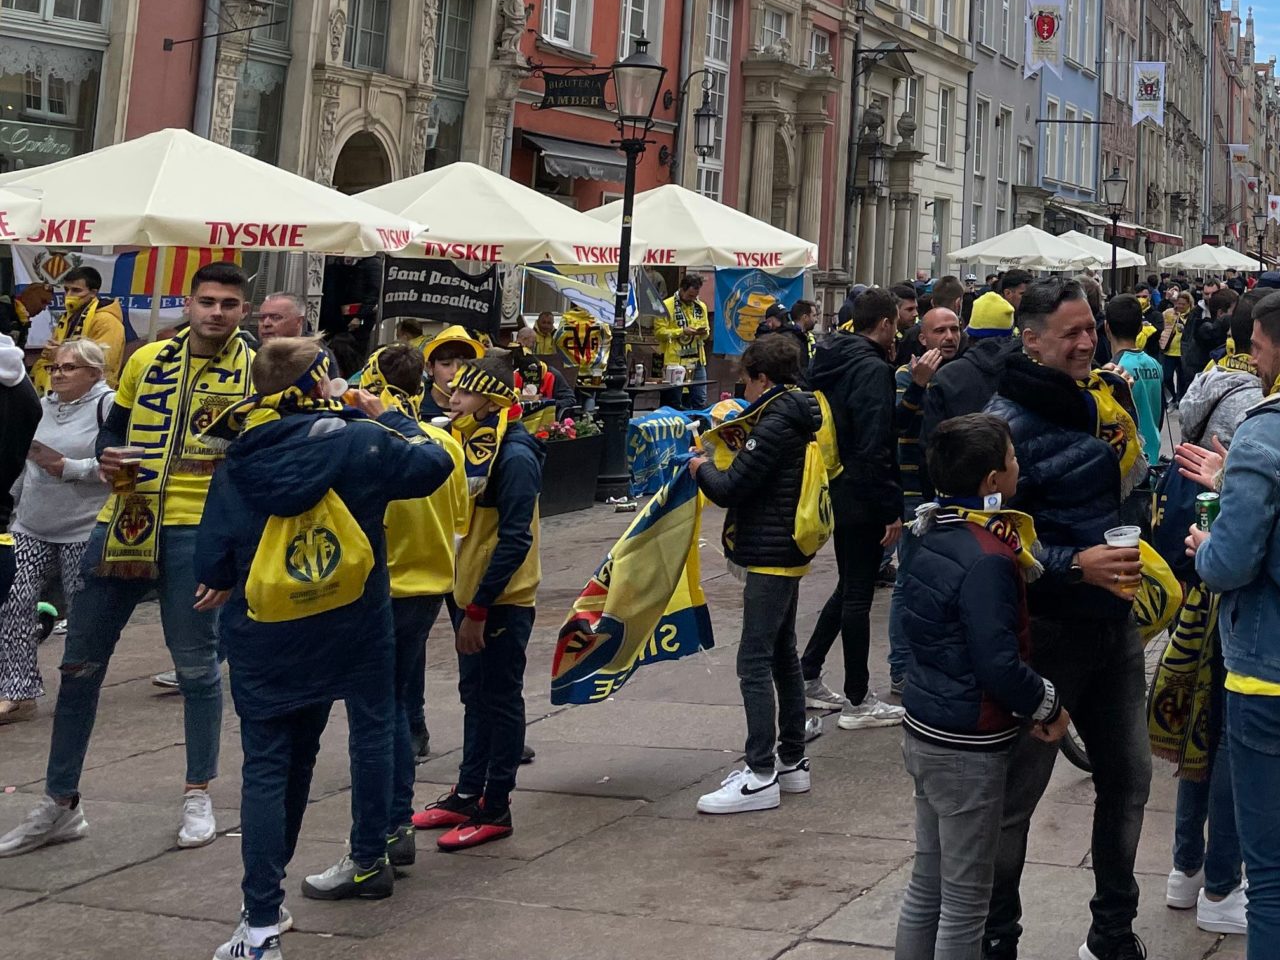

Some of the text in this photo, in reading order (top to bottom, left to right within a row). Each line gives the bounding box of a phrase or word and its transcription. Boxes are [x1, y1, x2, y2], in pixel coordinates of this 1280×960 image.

[546, 95, 600, 105] AMBER
[205, 221, 308, 248] TYSKIE
[422, 241, 505, 263] TYSKIE
[734, 251, 785, 268] TYSKIE
[388, 266, 494, 294] Sant Pasqual
[384, 288, 490, 314] amb nosaltres
[1199, 512, 1209, 532] ECH
